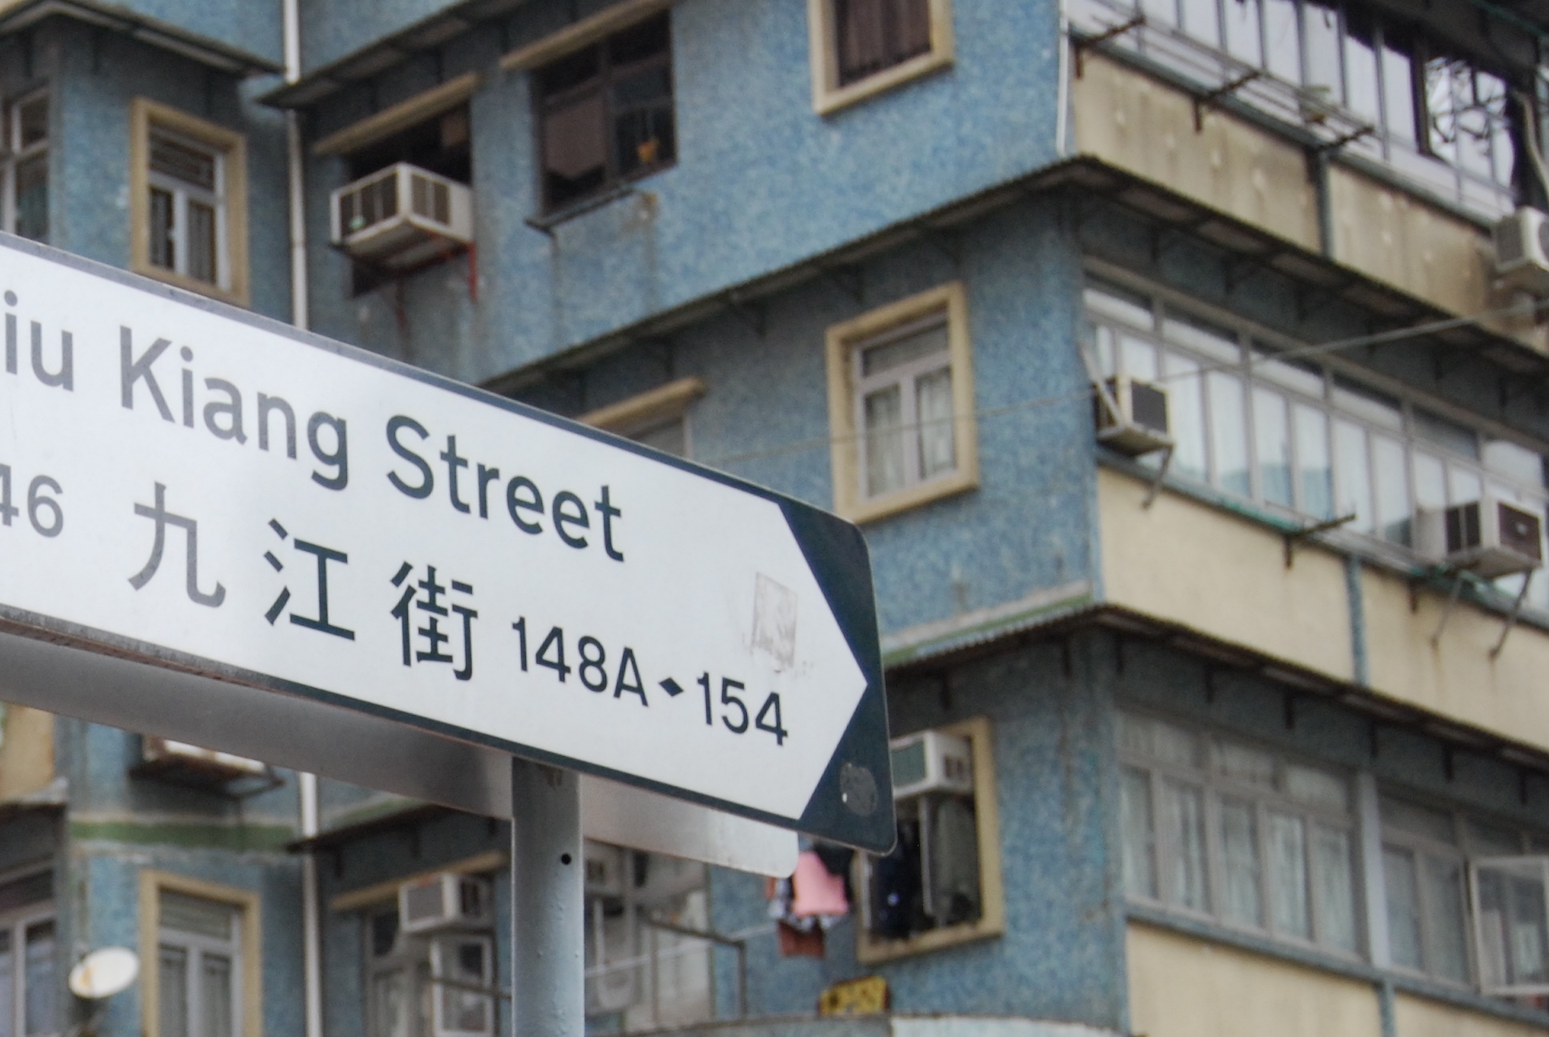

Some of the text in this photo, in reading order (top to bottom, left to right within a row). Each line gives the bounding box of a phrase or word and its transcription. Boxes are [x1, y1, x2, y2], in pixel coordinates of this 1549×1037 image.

[120, 325, 349, 492] Kiang
[385, 414, 625, 563] Street
[127, 481, 479, 682] 九江街
[511, 615, 789, 748] 148A 154
